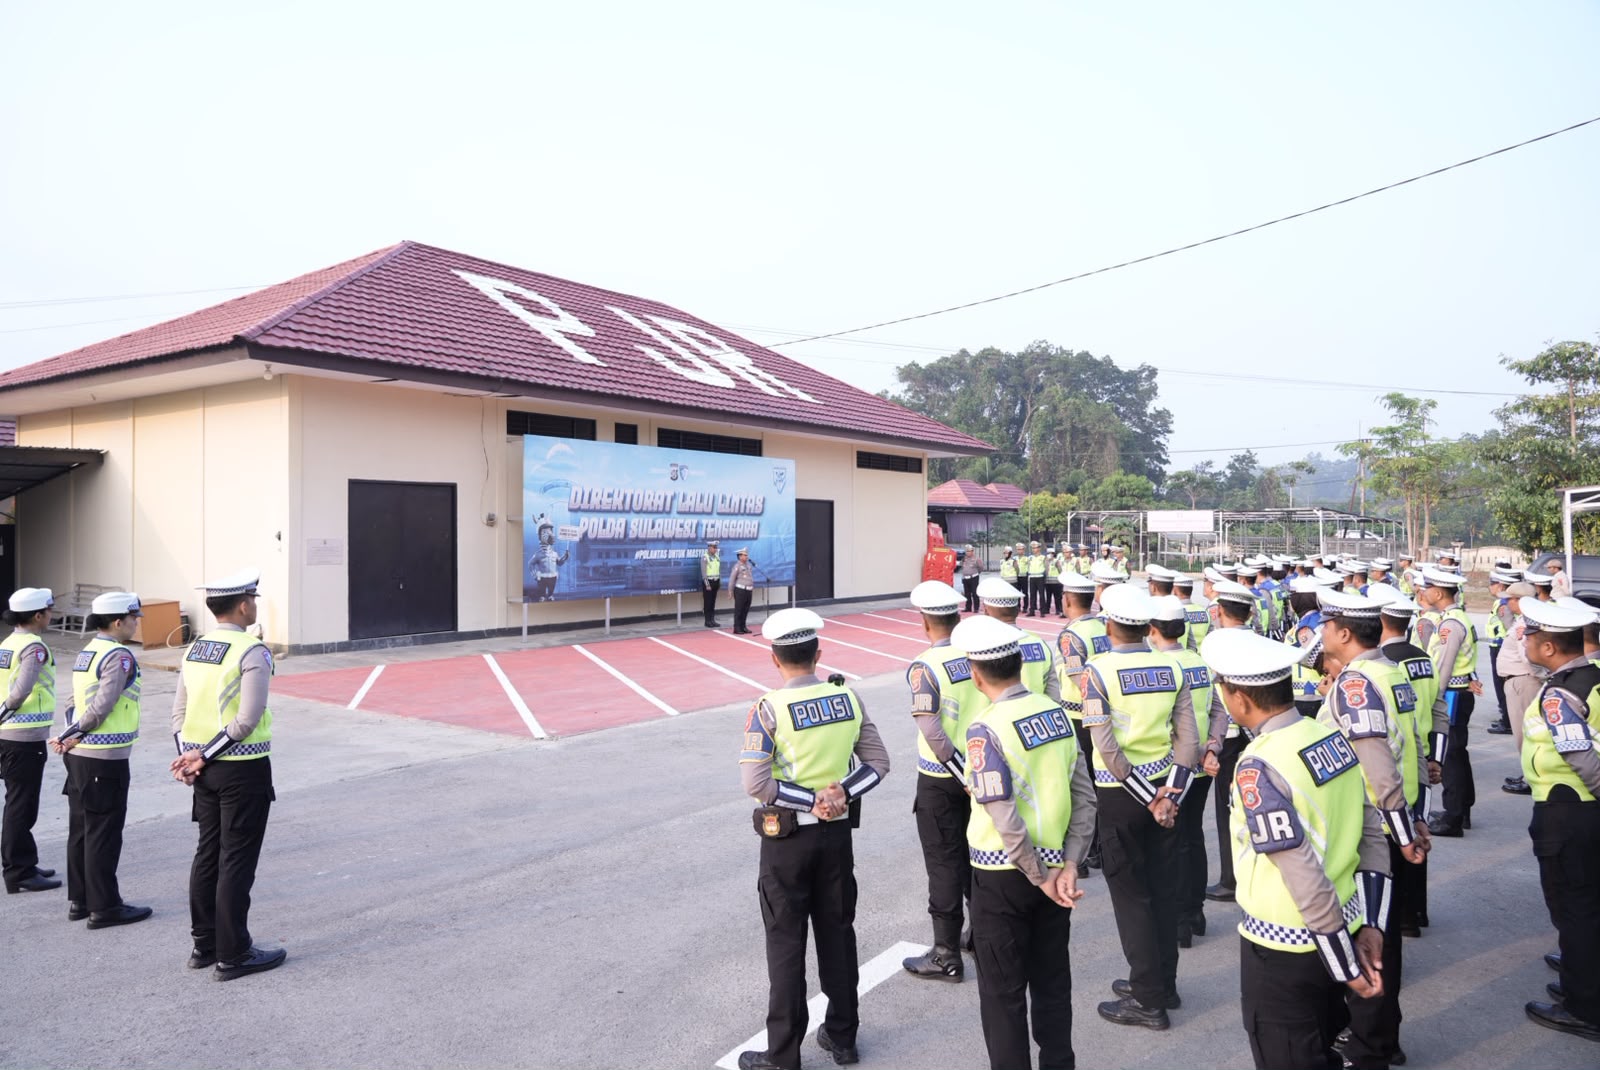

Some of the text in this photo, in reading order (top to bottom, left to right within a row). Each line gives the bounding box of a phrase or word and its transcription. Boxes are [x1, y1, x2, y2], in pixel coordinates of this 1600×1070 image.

[568, 487, 764, 516] DIREKTORAT LALU LINTAS
[579, 517, 627, 540] POLDA
[629, 518, 699, 540] SULAWESI
[701, 520, 760, 540] TENGGARA
[668, 549, 686, 559] UNTUK
[188, 642, 226, 663] POLISI
[1120, 671, 1175, 691] POLISI
[794, 697, 851, 726] POLISI
[1019, 711, 1071, 746] POLISI
[1305, 735, 1356, 780] POLISI
[969, 771, 1004, 798] JR
[1251, 810, 1295, 845] JR
